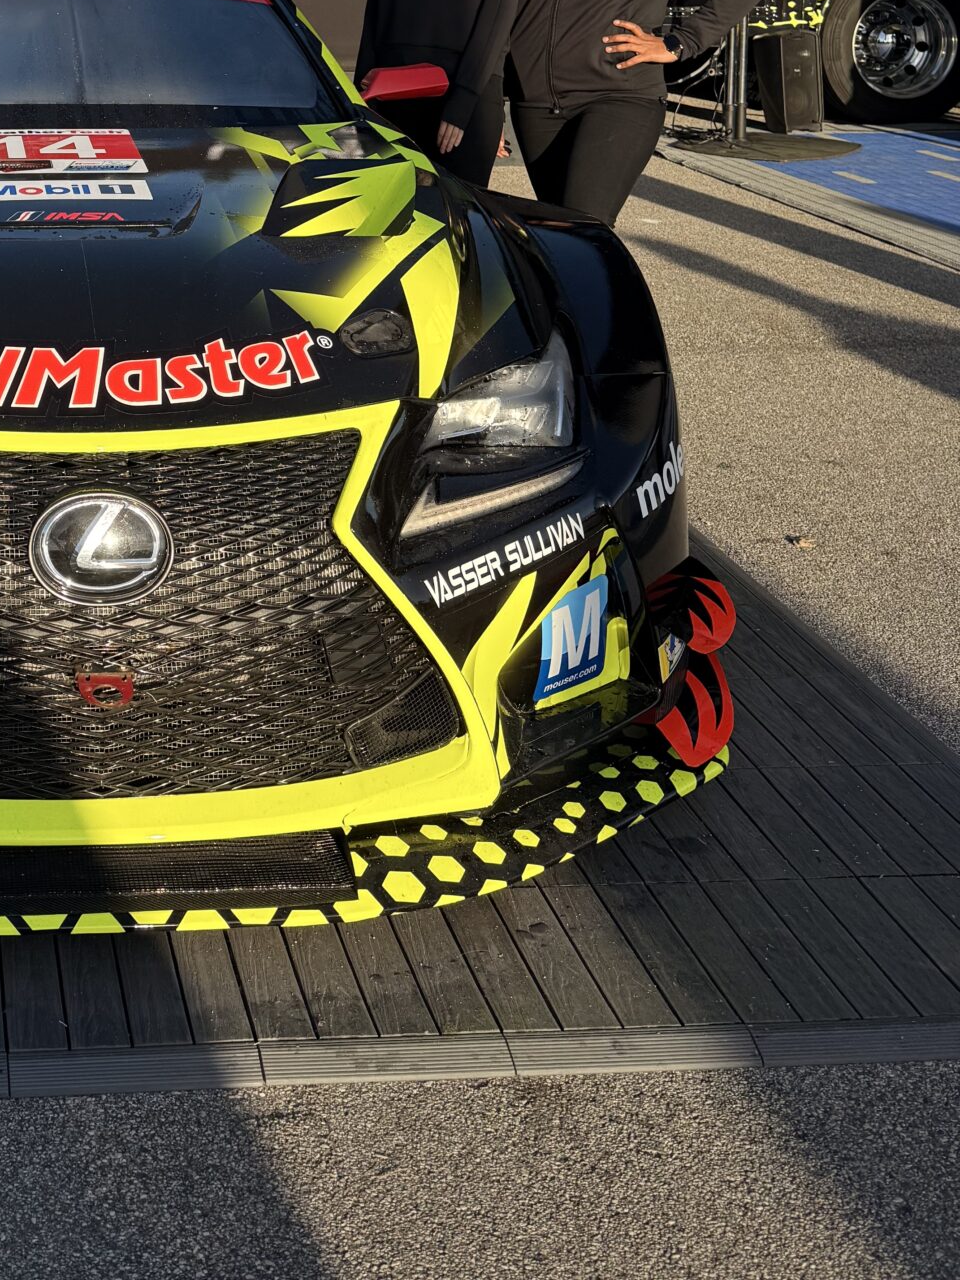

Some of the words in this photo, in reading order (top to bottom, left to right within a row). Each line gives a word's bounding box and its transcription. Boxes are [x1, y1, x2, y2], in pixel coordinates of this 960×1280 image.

[44, 211, 125, 221] IMSA
[424, 550, 505, 608] VASSER
[504, 512, 586, 572] SULLIVAN
[547, 587, 603, 679] M
[543, 663, 597, 693] mouser.com
